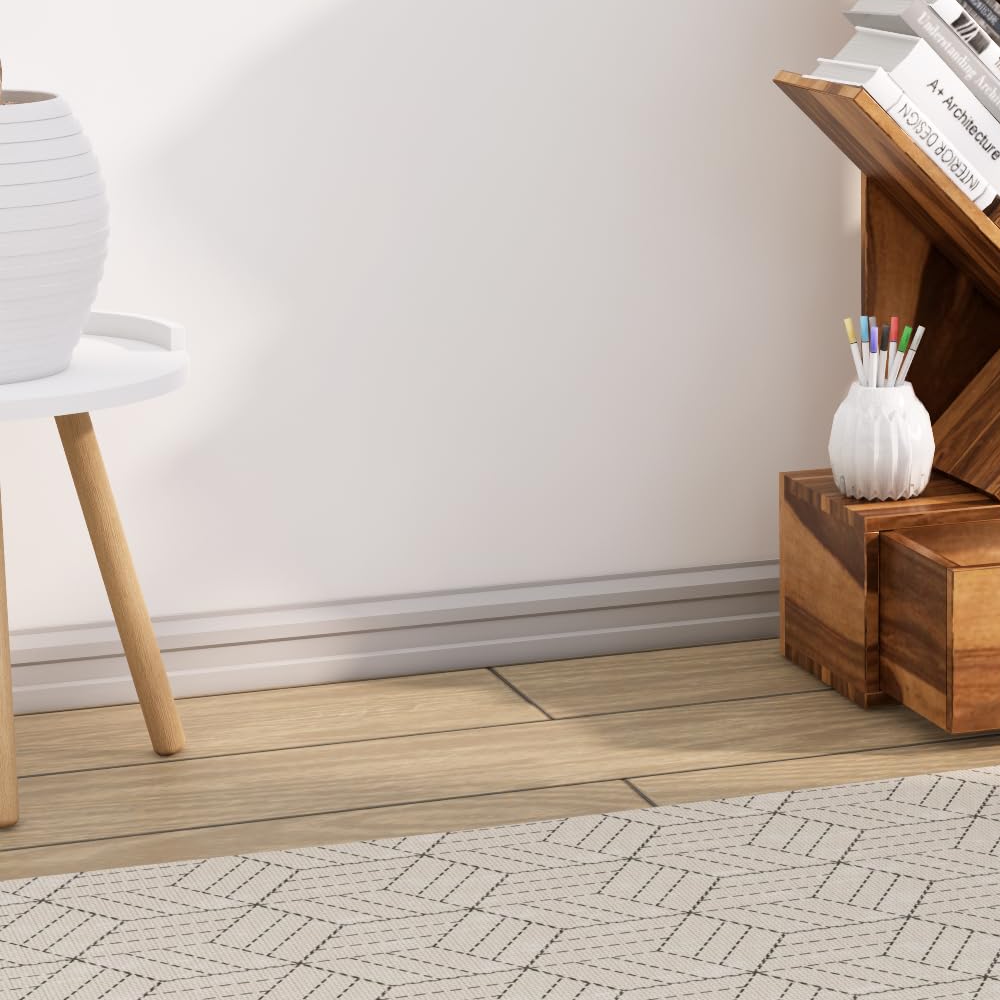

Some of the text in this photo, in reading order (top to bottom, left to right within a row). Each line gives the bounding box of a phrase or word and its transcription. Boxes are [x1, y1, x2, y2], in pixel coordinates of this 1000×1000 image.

[917, 11, 976, 80] Understanding
[899, 103, 980, 191] INTERIOR DESIGN
[927, 79, 1000, 161] A+ Architecture
